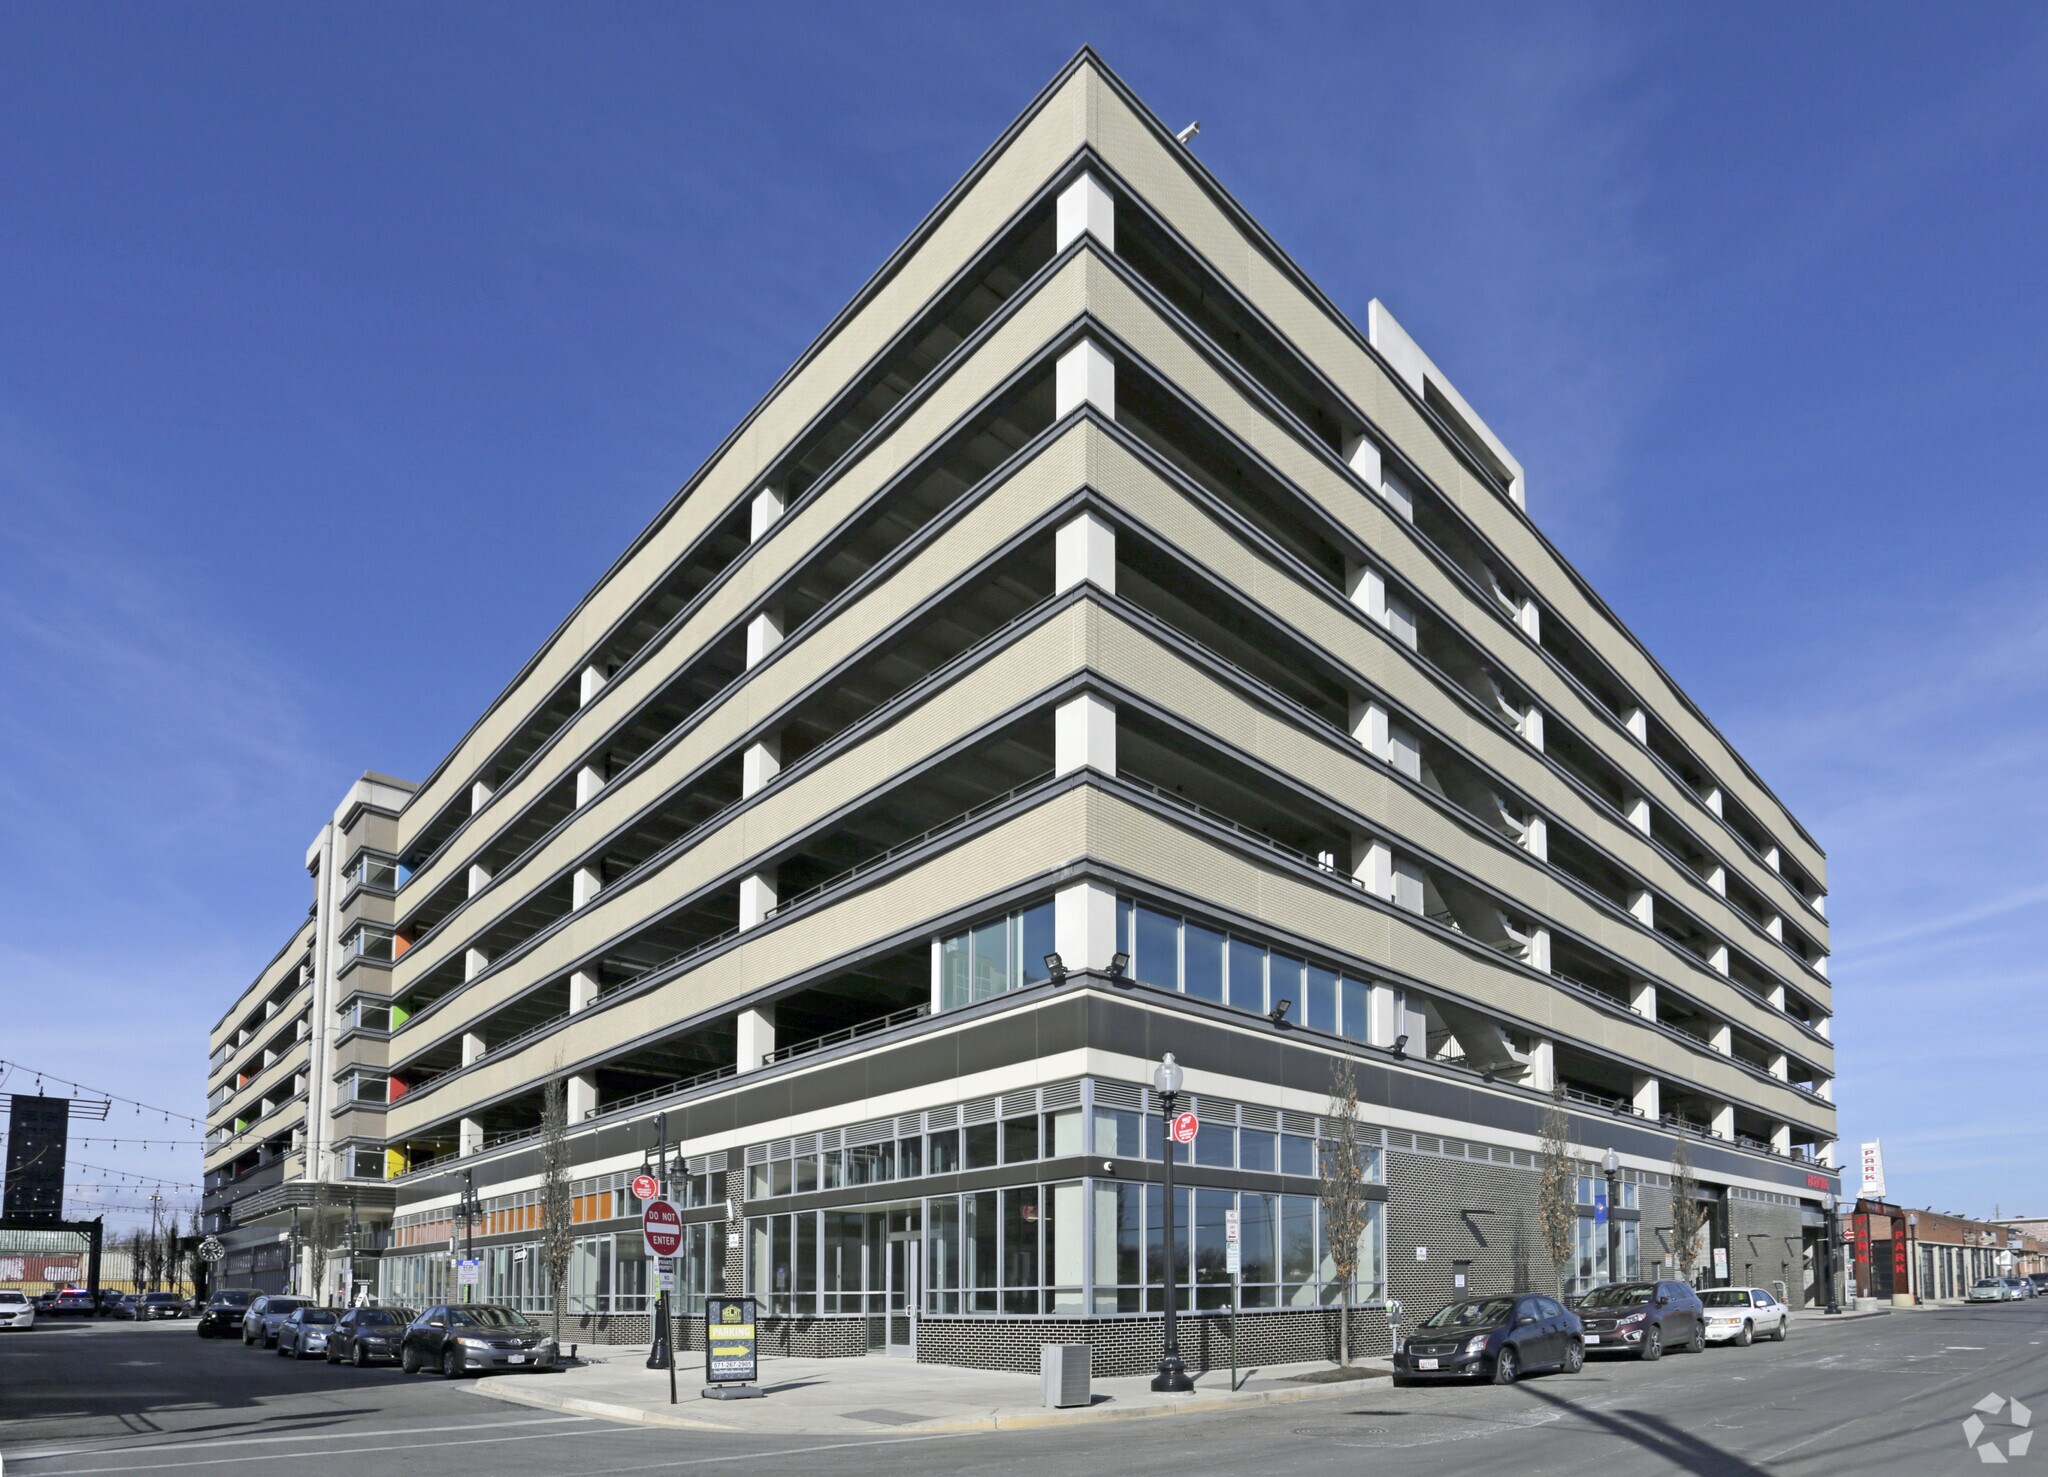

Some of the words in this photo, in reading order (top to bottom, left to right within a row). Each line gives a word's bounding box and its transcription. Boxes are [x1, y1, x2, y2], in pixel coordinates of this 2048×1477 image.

[1864, 1150, 1875, 1180] PARK
[648, 1211, 659, 1220] DO
[662, 1212, 676, 1222] NOT
[653, 1235, 675, 1246] ENTER
[1857, 1215, 1869, 1263] PARK
[1895, 1231, 1905, 1273] PARK
[713, 1327, 751, 1336] PARKING
